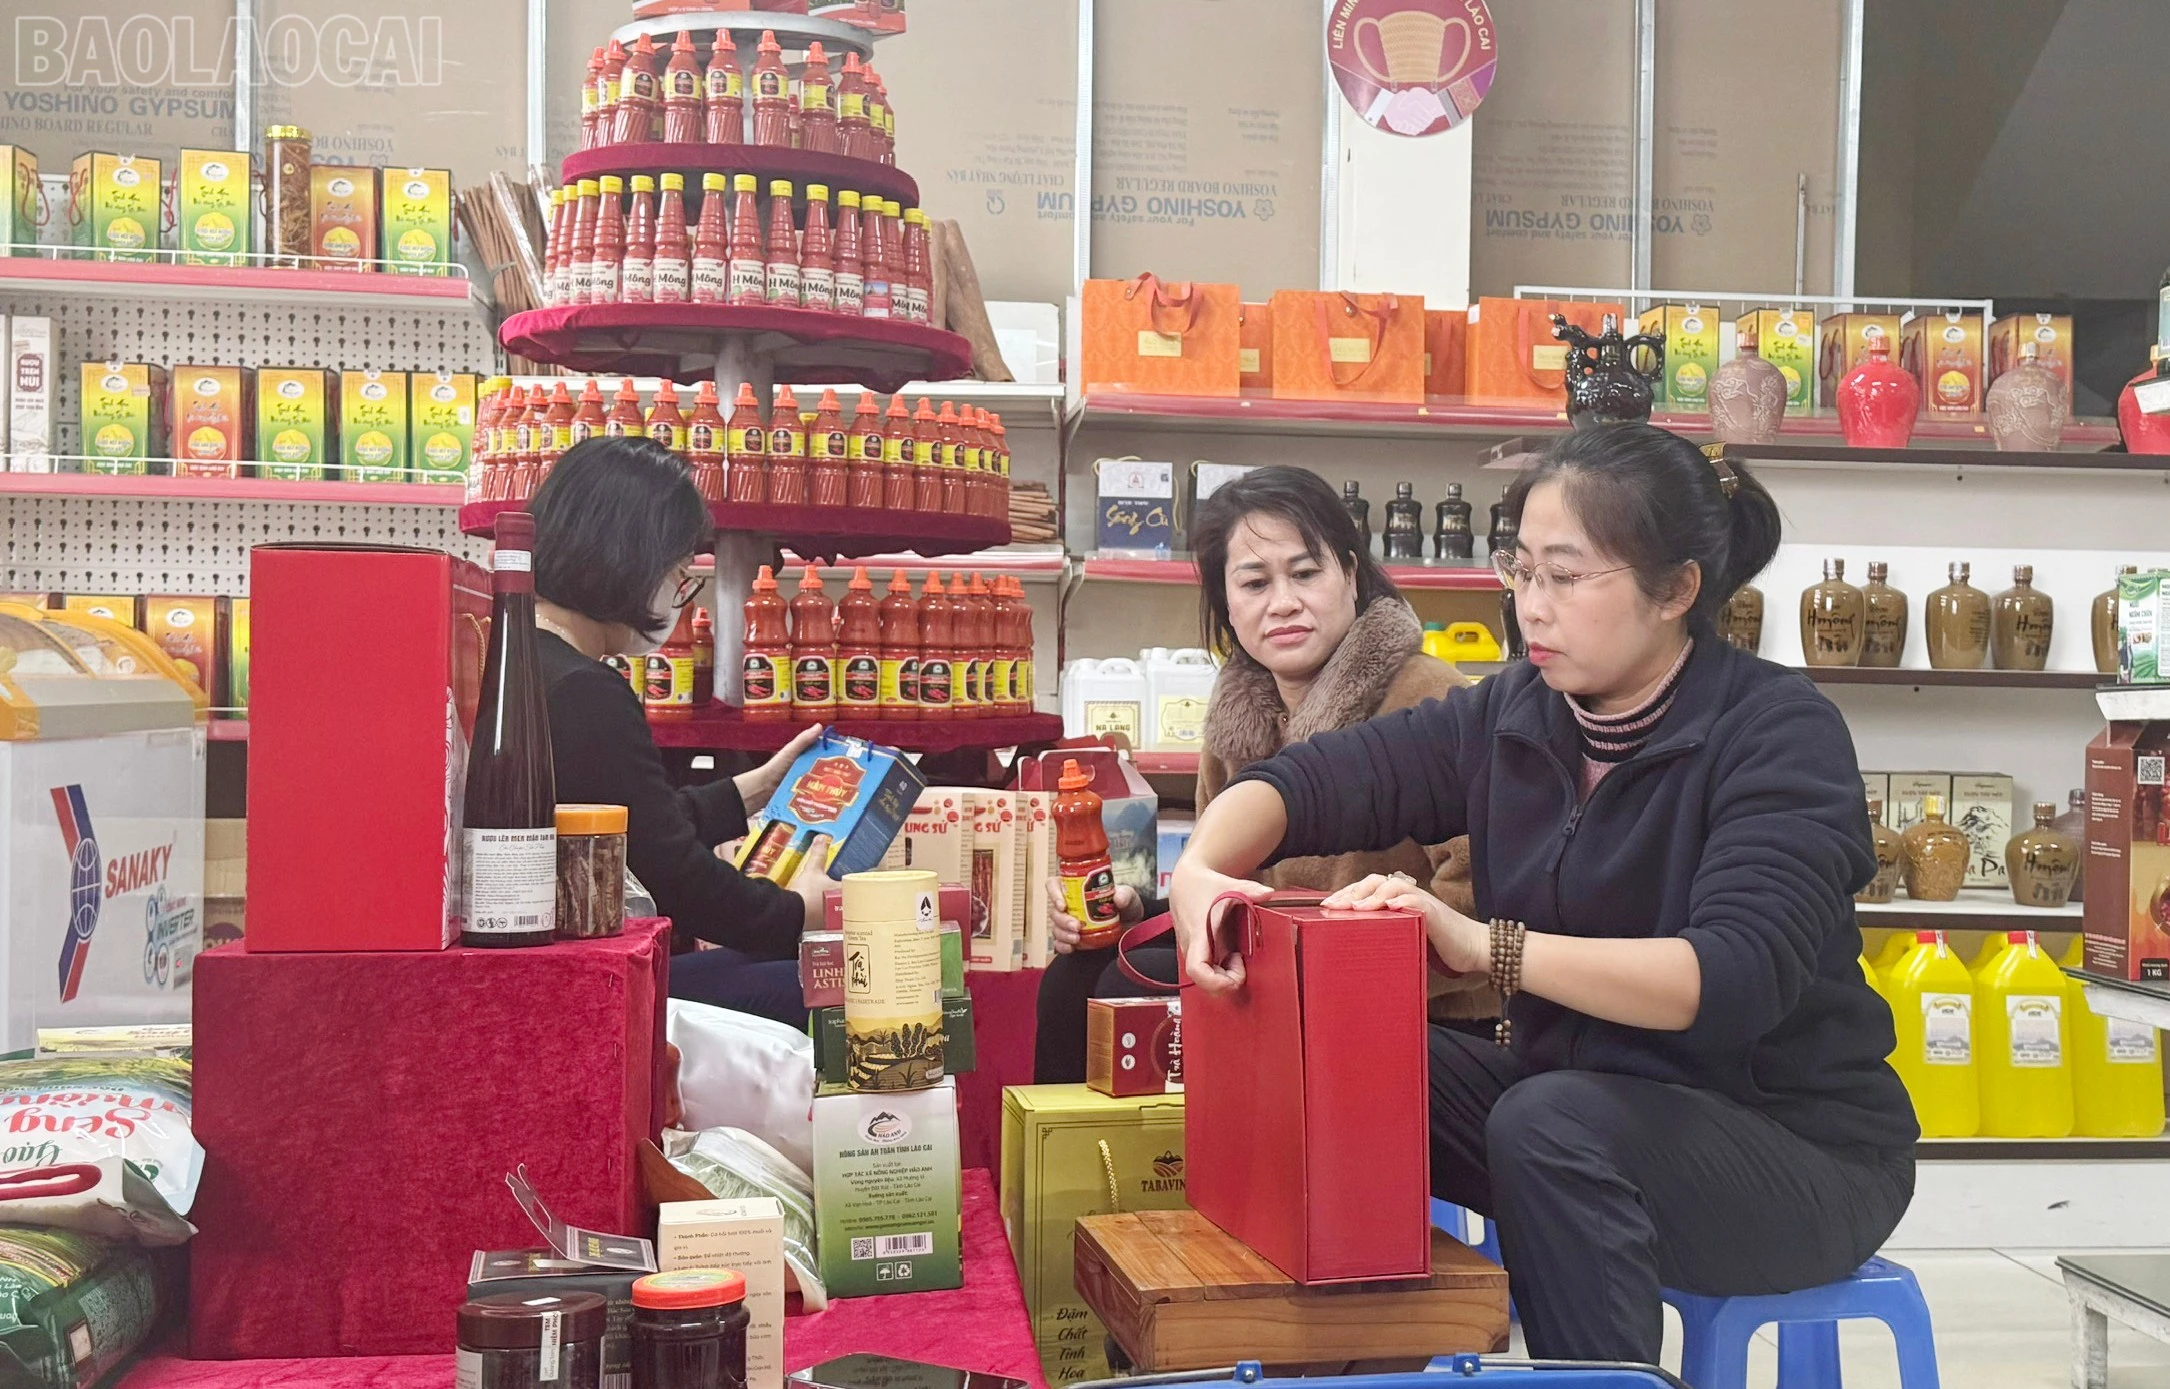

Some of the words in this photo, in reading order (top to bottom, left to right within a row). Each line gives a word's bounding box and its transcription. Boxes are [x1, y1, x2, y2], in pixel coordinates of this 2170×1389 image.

[1477, 28, 1491, 50] CAI
[89, 86, 117, 96] your
[122, 86, 158, 97] safety
[164, 87, 188, 98] and
[4, 90, 118, 115] YOSHINO
[129, 96, 236, 119] GYPSUM
[35, 117, 82, 133] BOARD
[87, 119, 153, 136] REGULAR
[1115, 176, 1175, 192] REGULAR
[1178, 180, 1220, 195] BOARD
[1223, 183, 1278, 197] YOSHINO
[1147, 197, 1246, 218] YOSHINO
[1561, 194, 1615, 209] REGULAR
[1109, 213, 1144, 224] safety
[1148, 215, 1172, 225] your
[1176, 216, 1195, 227] For
[1486, 209, 1580, 229] GYPSUM
[1486, 228, 1528, 239] comfort
[1531, 230, 1551, 240] and
[658, 273, 687, 288] Mông
[695, 273, 723, 288] Mông
[742, 274, 764, 286] Môn
[768, 279, 777, 288] H
[105, 843, 173, 899] SANAKY
[156, 908, 195, 940] INVERTER
[812, 967, 844, 978] LINH
[2151, 968, 2162, 977] KG
[3, 1140, 62, 1167] Gạo
[870, 1148, 879, 1156] AN
[1056, 1307, 1088, 1322] Đậm
[1058, 1366, 1085, 1380] Hoa
